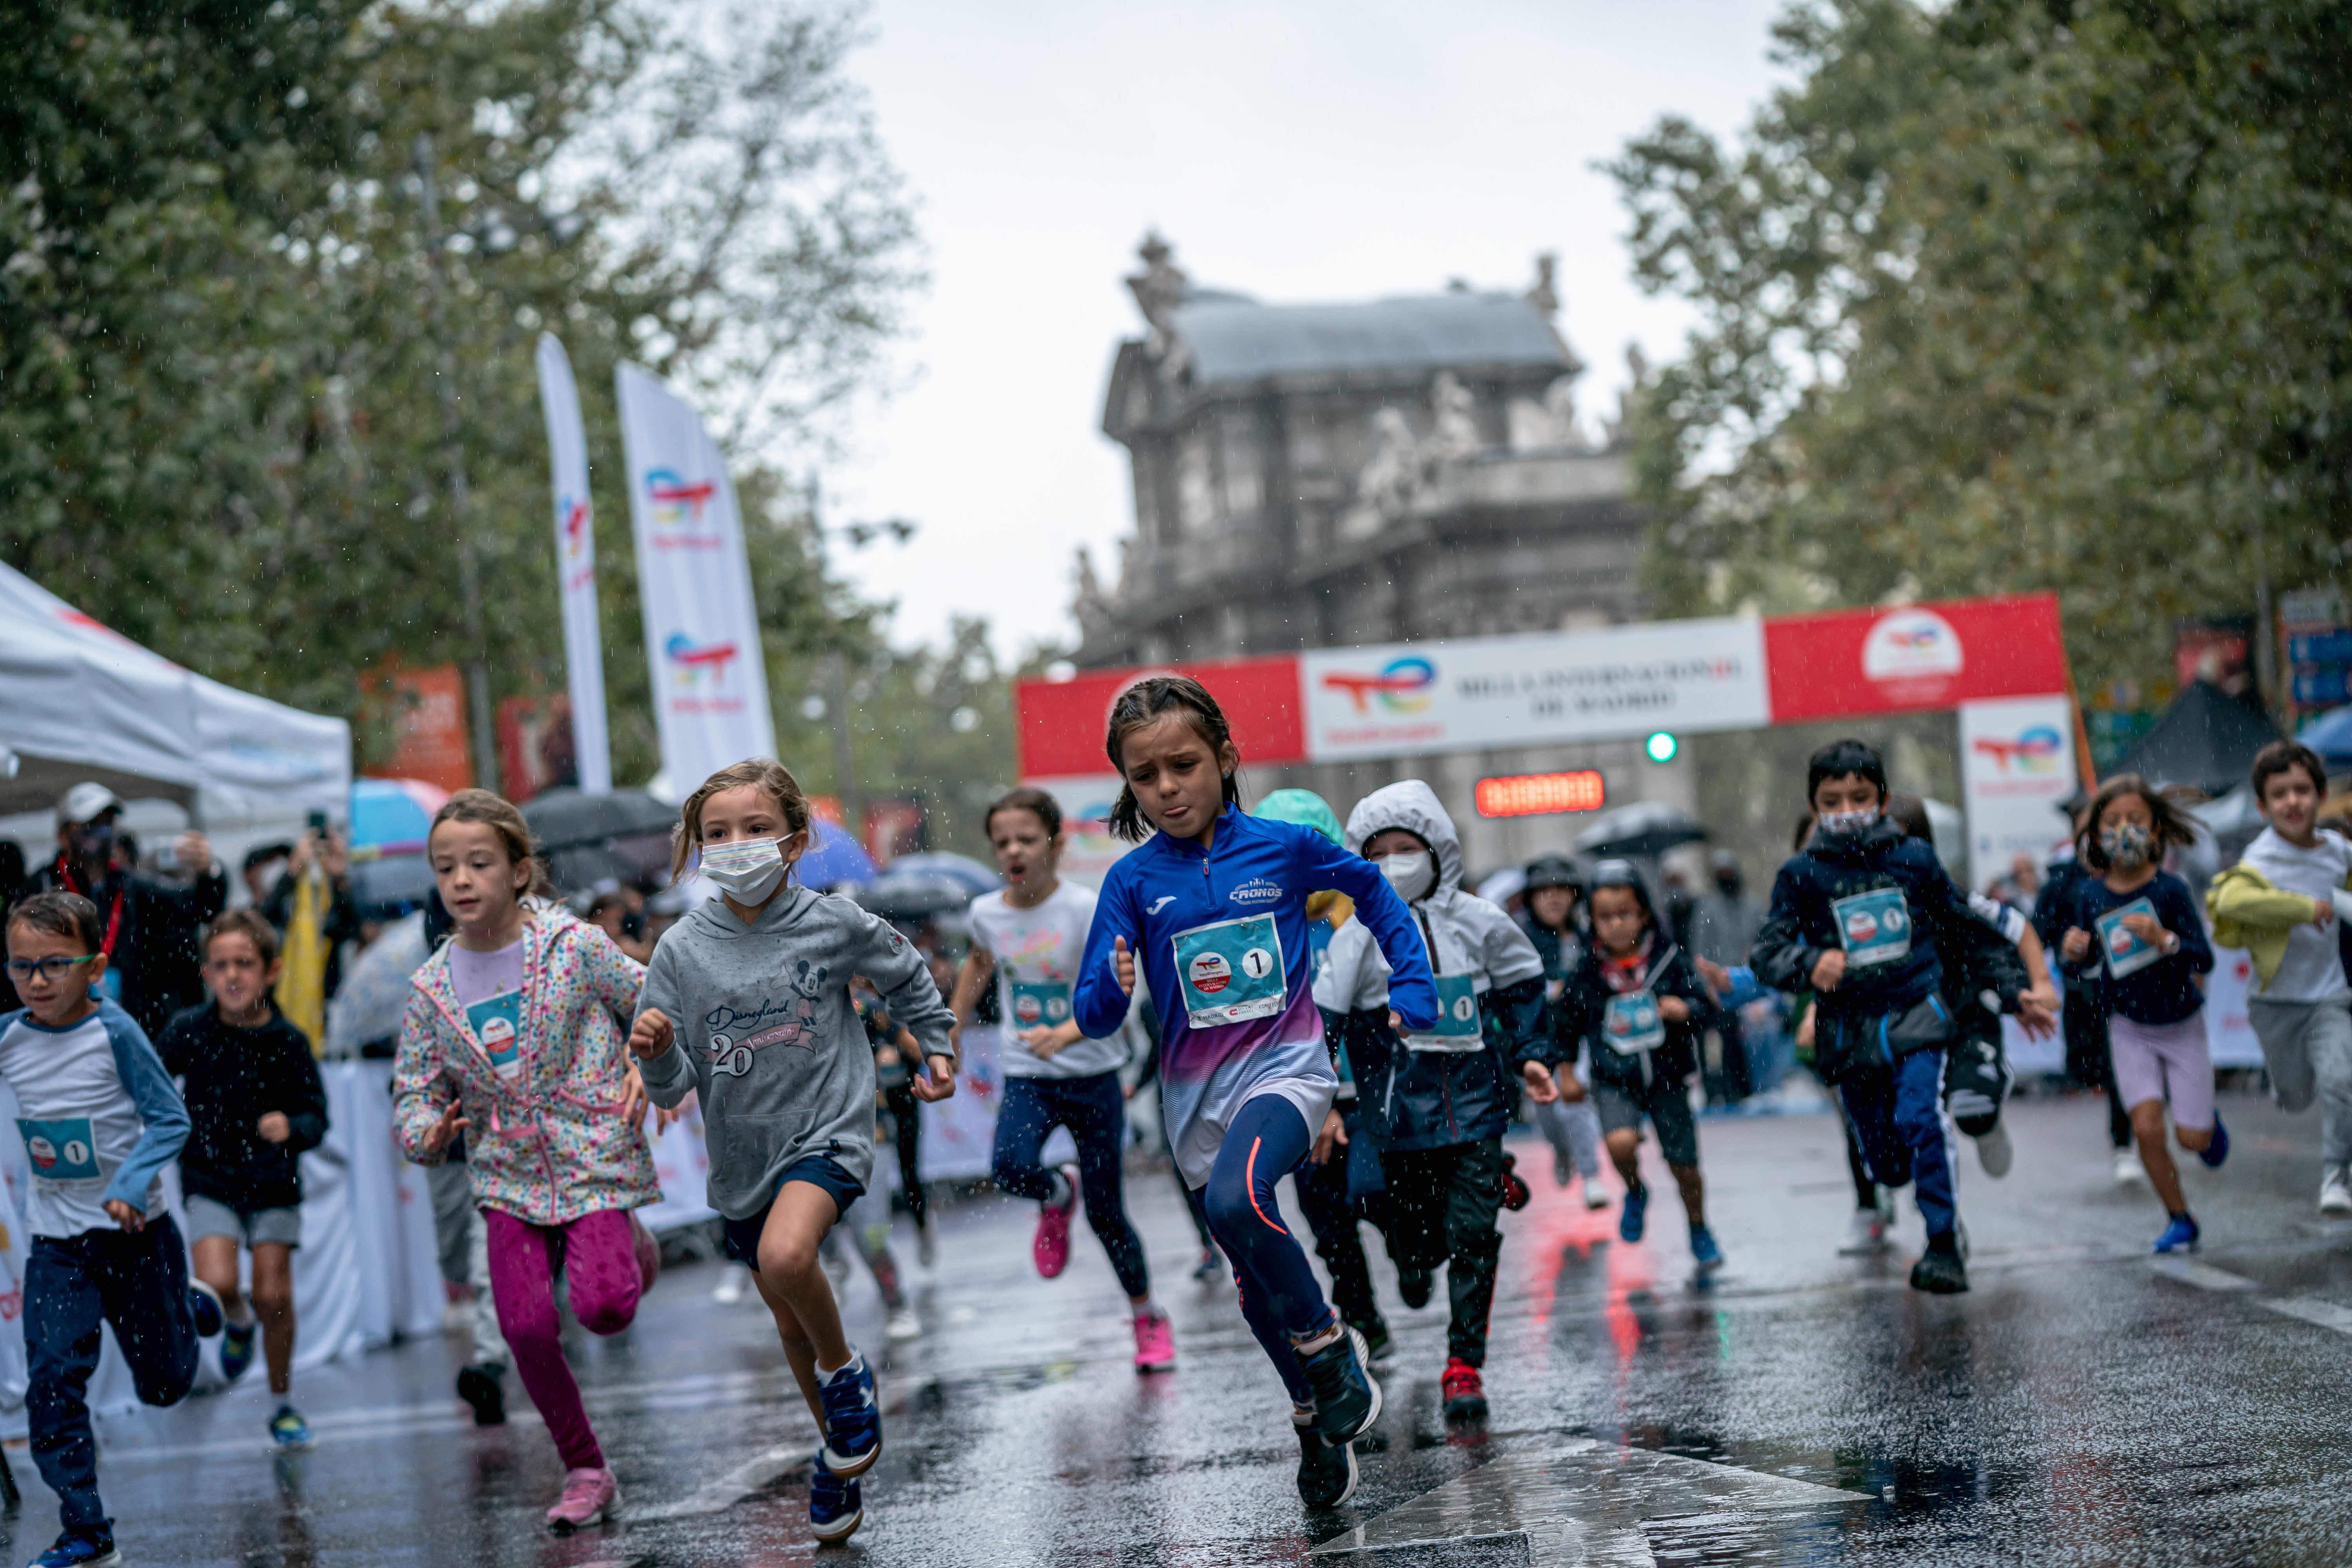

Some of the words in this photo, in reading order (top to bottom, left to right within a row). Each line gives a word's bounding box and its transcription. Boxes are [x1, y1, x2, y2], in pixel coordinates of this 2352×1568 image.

[1229, 888, 1283, 900] CRONOS
[1250, 952, 1262, 974] 1
[706, 998, 789, 1032] Disneyland
[1461, 1000, 1467, 1016] 1
[710, 1032, 755, 1078] 20
[71, 1143, 80, 1161] 1
